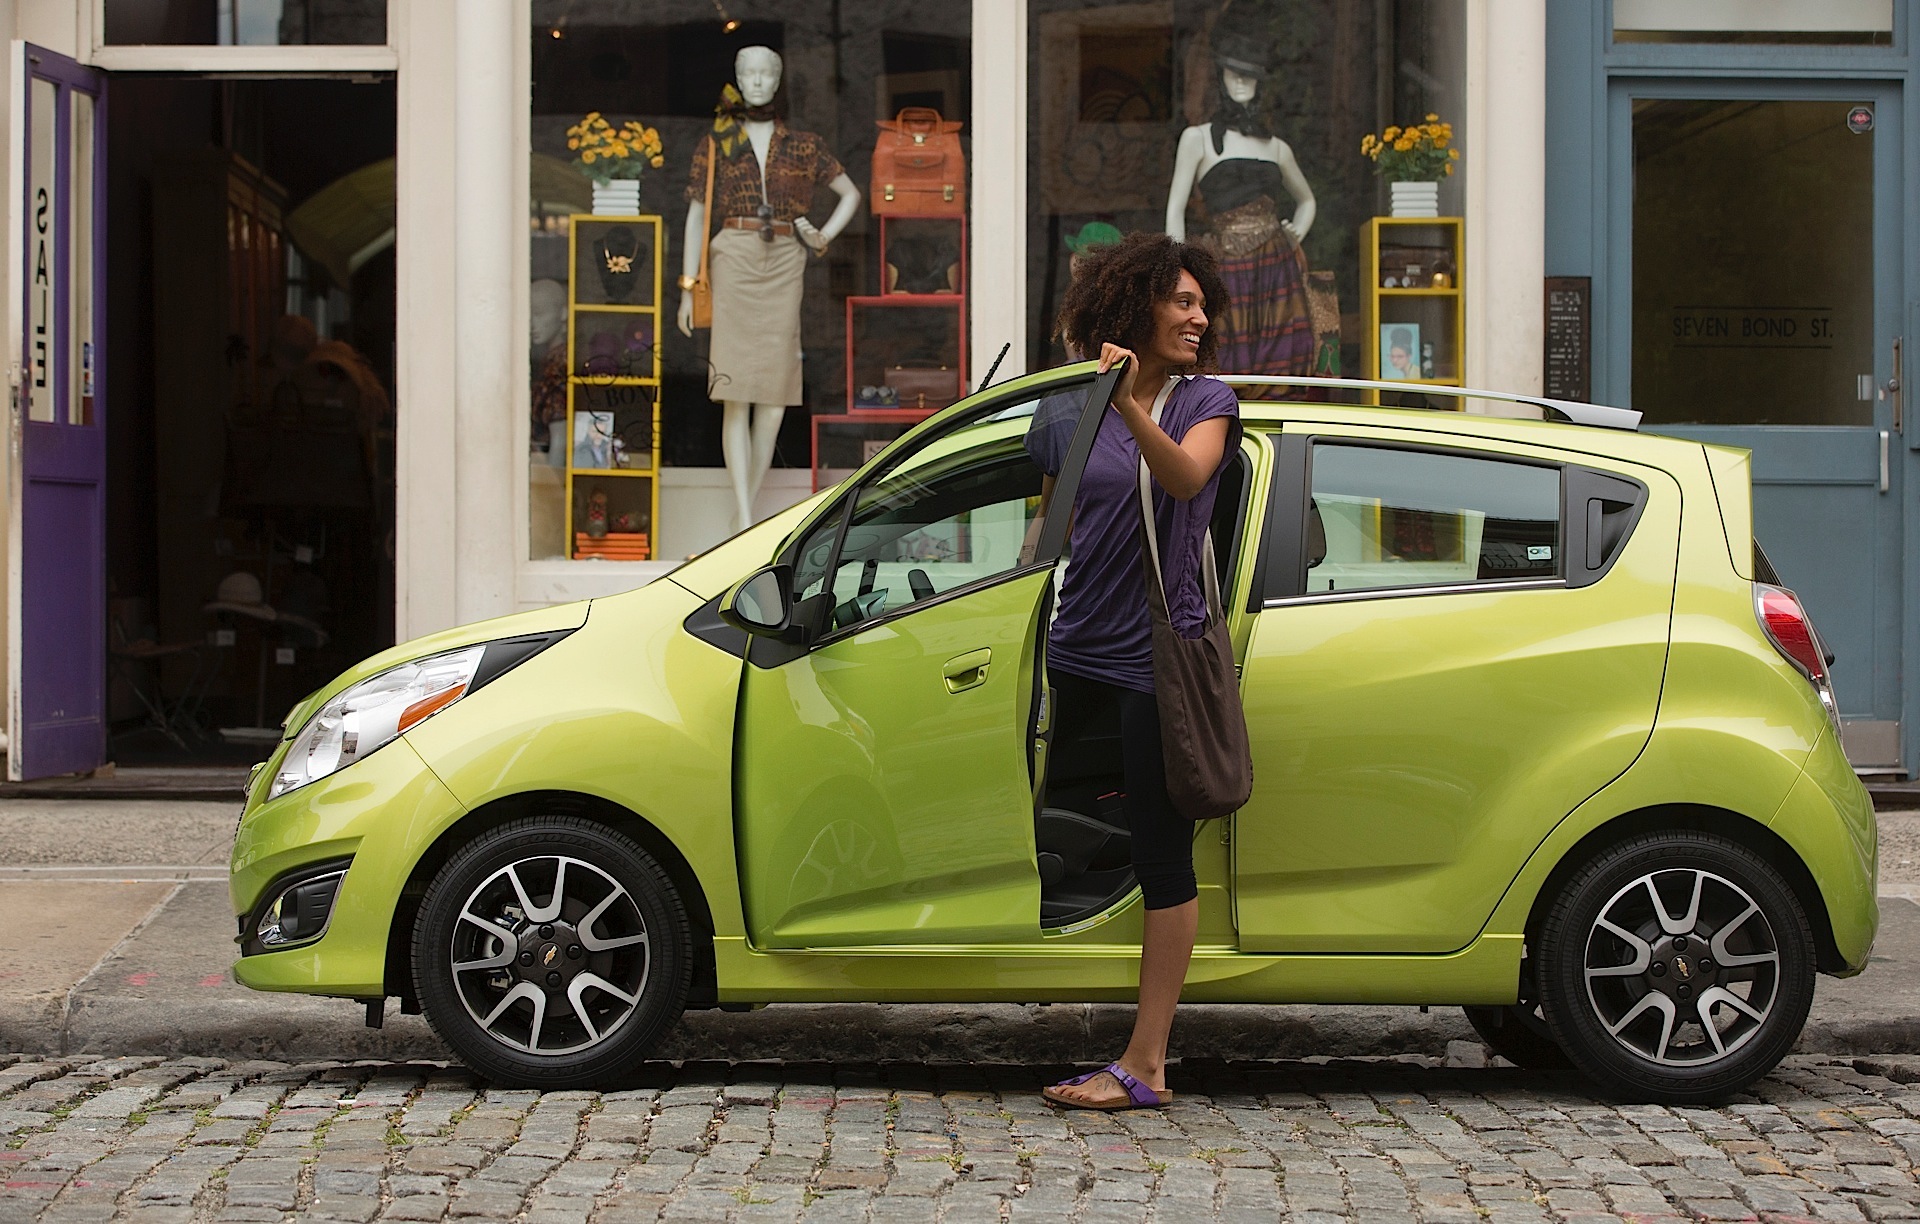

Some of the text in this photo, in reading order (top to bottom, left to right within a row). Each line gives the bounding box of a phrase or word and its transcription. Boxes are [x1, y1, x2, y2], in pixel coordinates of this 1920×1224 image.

[1672, 317, 1834, 338] SEVEN BOND ST.
